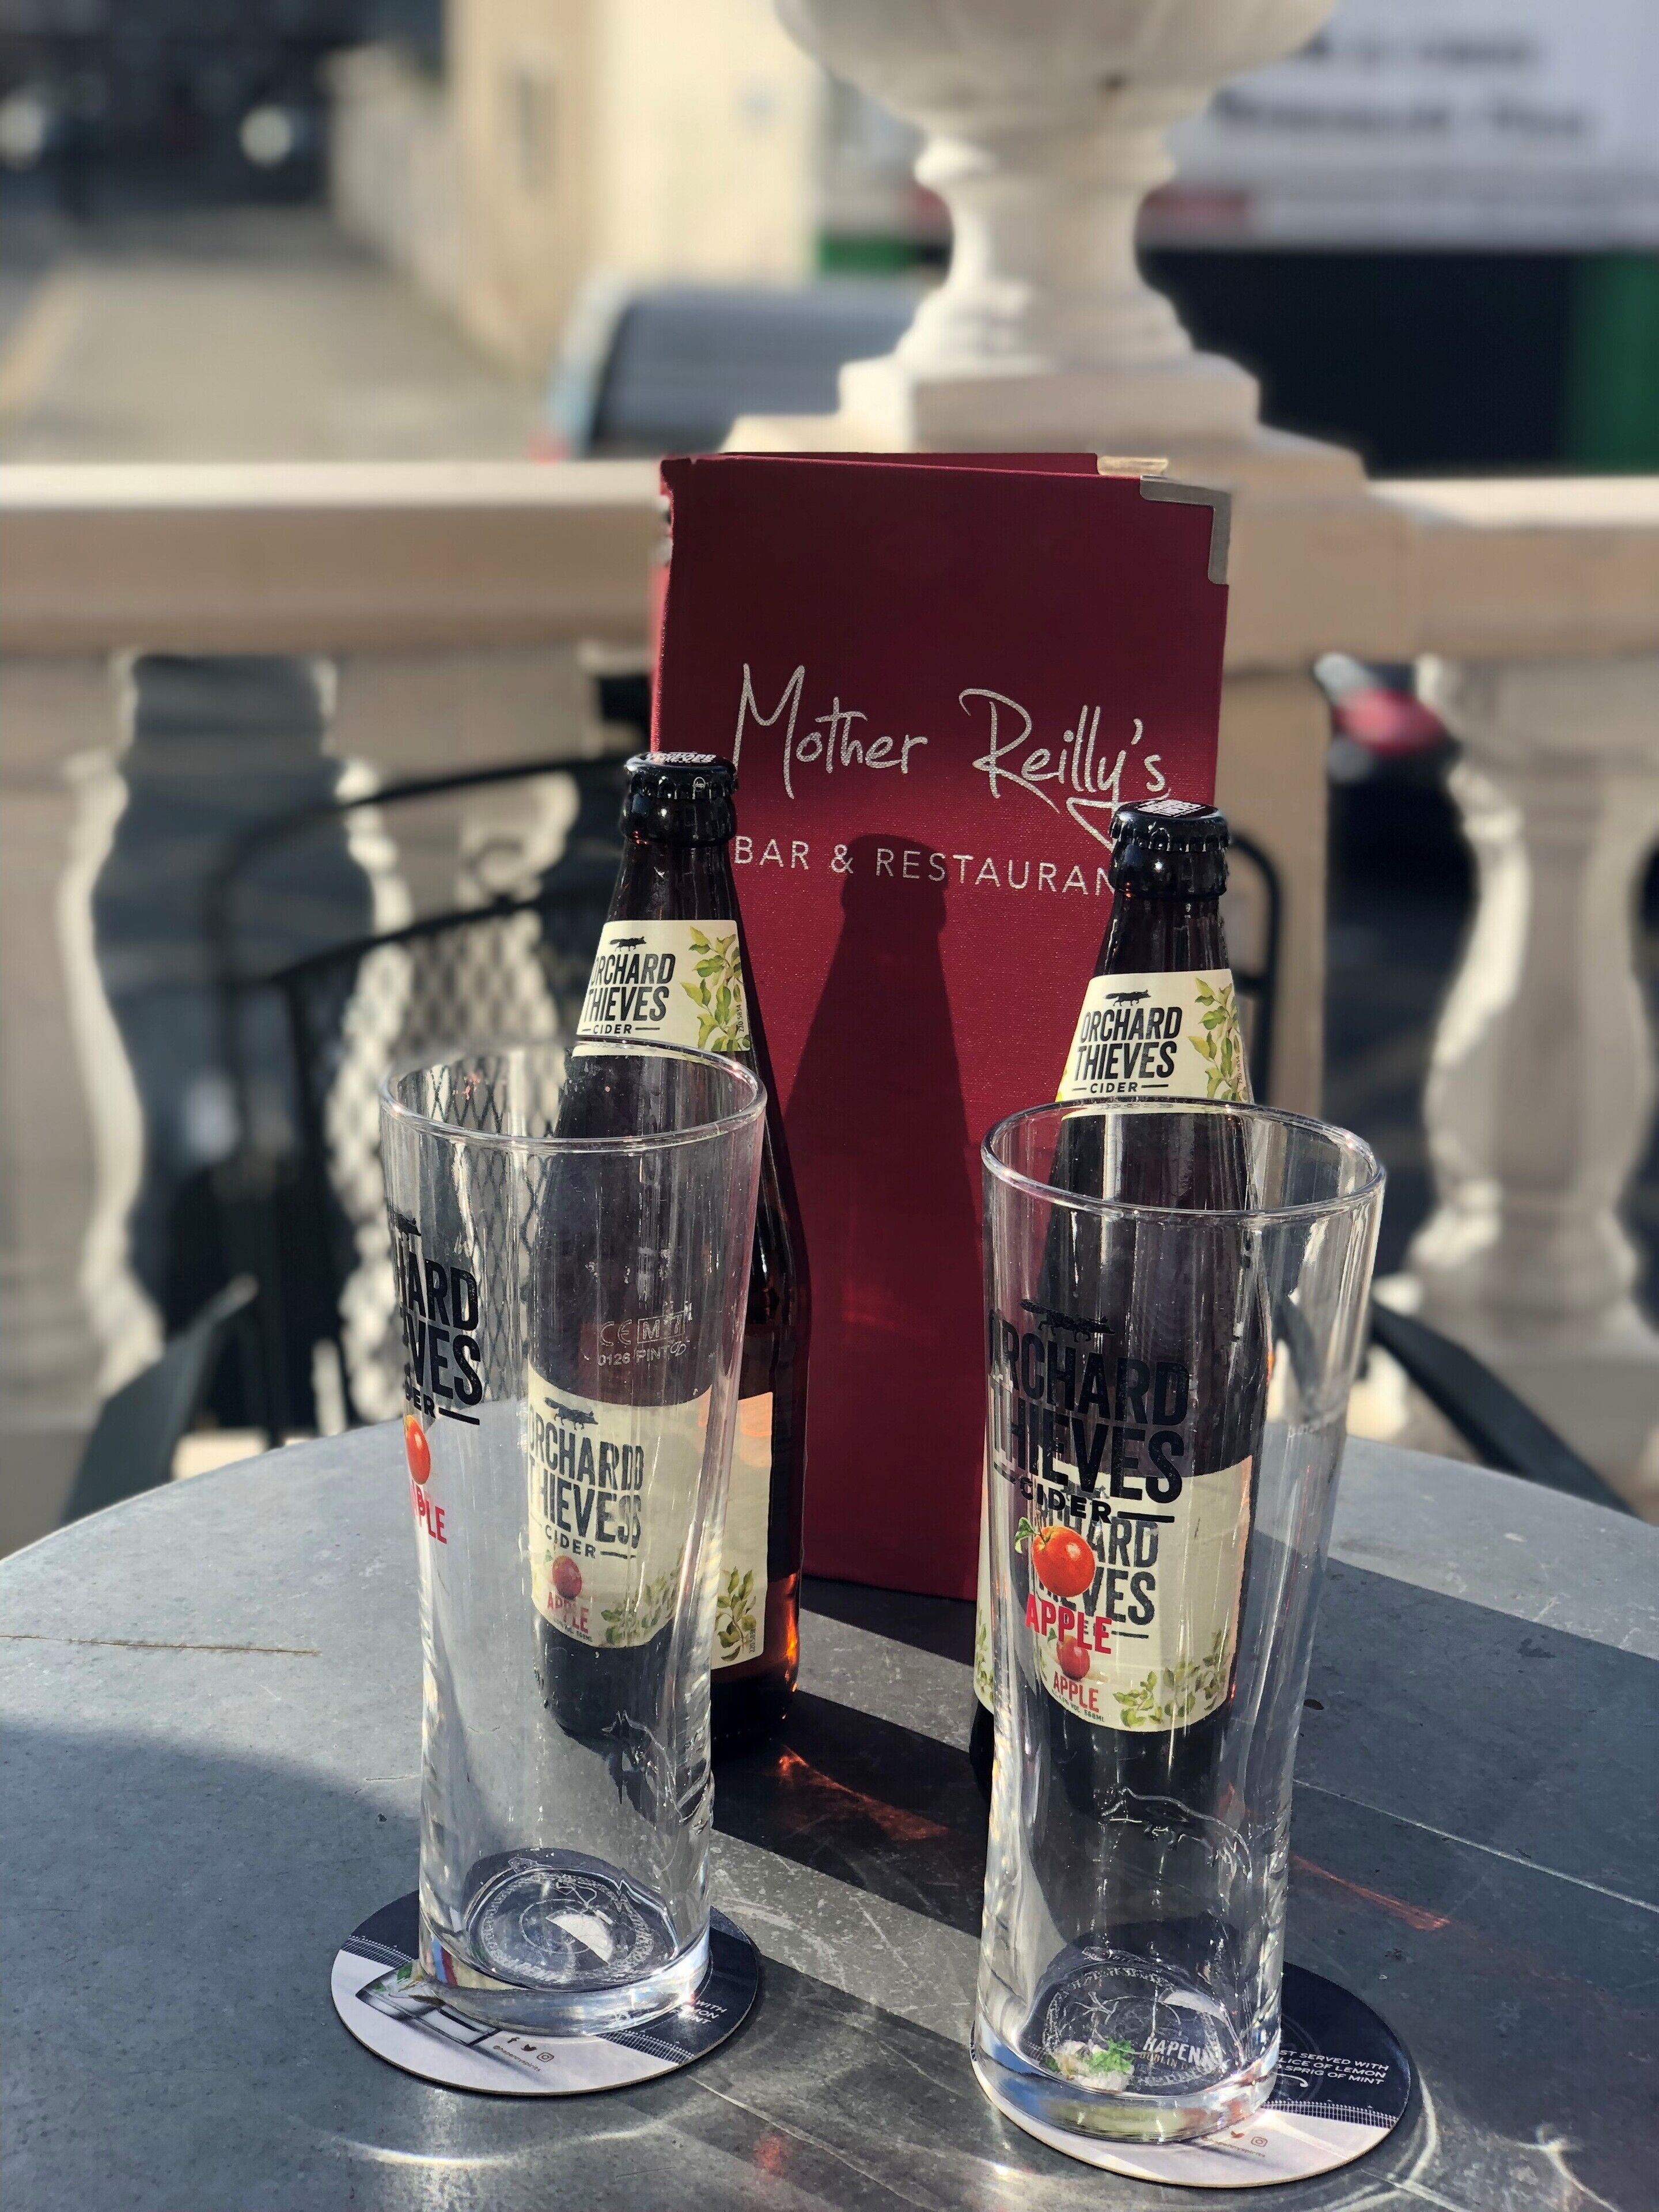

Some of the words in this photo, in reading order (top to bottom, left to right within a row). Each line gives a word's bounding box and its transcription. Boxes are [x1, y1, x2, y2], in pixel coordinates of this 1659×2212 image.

[733, 663, 927, 799] Mother
[958, 688, 1171, 853] Reilly's
[735, 835, 809, 870] BAR
[831, 844, 853, 874] &
[876, 848, 1115, 896] RESTAURAN
[583, 986, 670, 1022] THIEVES
[593, 1024, 632, 1035] CIDER
[1080, 1007, 1182, 1043] ORCHARD
[1074, 1040, 1177, 1081] THIEVES
[1090, 1082, 1138, 1093] CIDER
[597, 1353, 631, 1366] 0126
[1020, 1476, 1112, 1524] CIDER
[546, 1525, 596, 1559] CIDER
[1024, 1594, 1112, 1655] APPLE
[1053, 1671, 1099, 1713] APPLE
[695, 2000, 728, 2013] WITH
[1285, 2066, 1324, 2076] SPRIG
[1349, 2075, 1384, 2085] MINT
[1299, 2053, 1351, 2065] SERVED
[1354, 2061, 1389, 2071] WITH
[1335, 2065, 1387, 2078] LEMON
